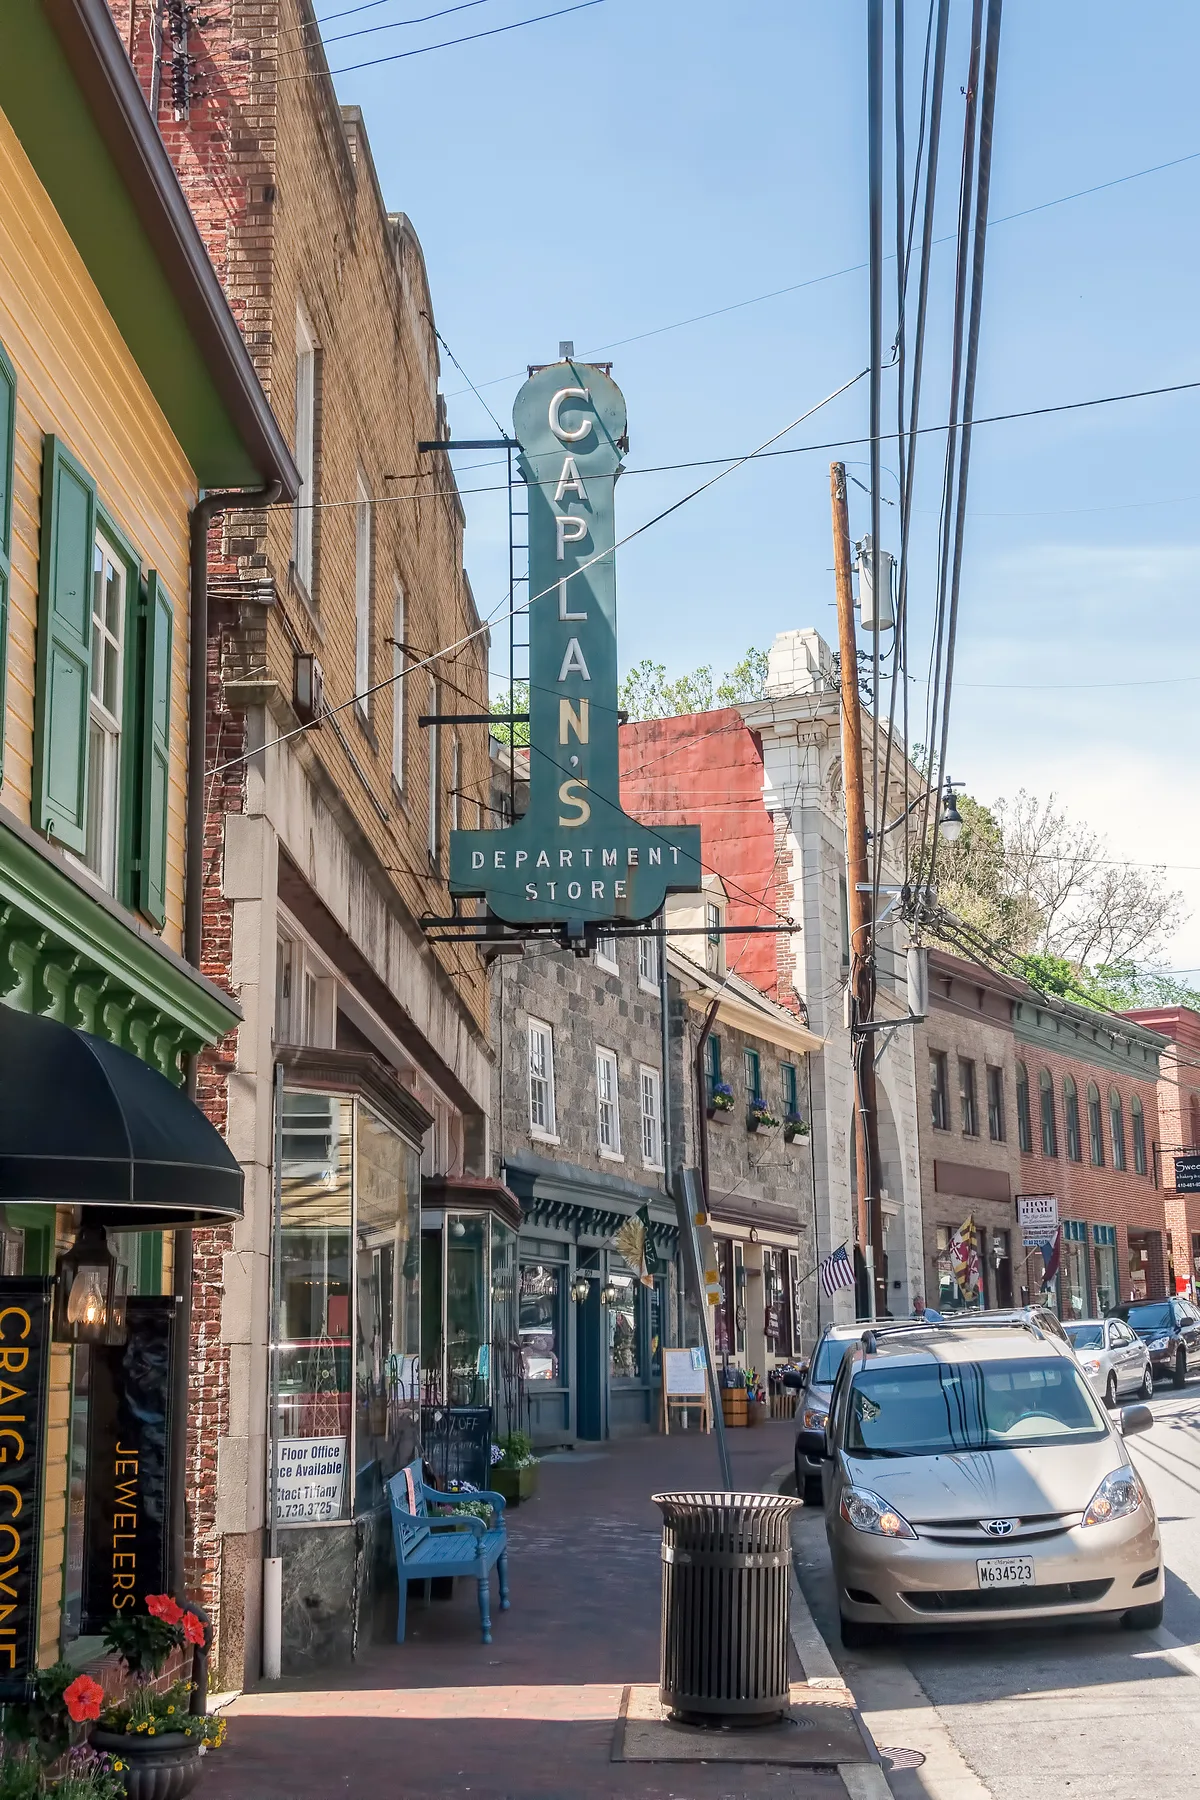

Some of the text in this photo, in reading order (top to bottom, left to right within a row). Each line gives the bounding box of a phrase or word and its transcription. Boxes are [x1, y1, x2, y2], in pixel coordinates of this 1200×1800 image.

[548, 388, 592, 829] CAPLAN'S
[471, 846, 682, 869] DEPARTMENT
[525, 880, 627, 900] STORE
[0, 1307, 31, 1463] CRAIG
[281, 1447, 308, 1460] Floor
[311, 1445, 340, 1459] Office
[295, 1461, 342, 1477] Available
[112, 1441, 139, 1609] JEWELERS
[980, 1565, 1032, 1582] M634523
